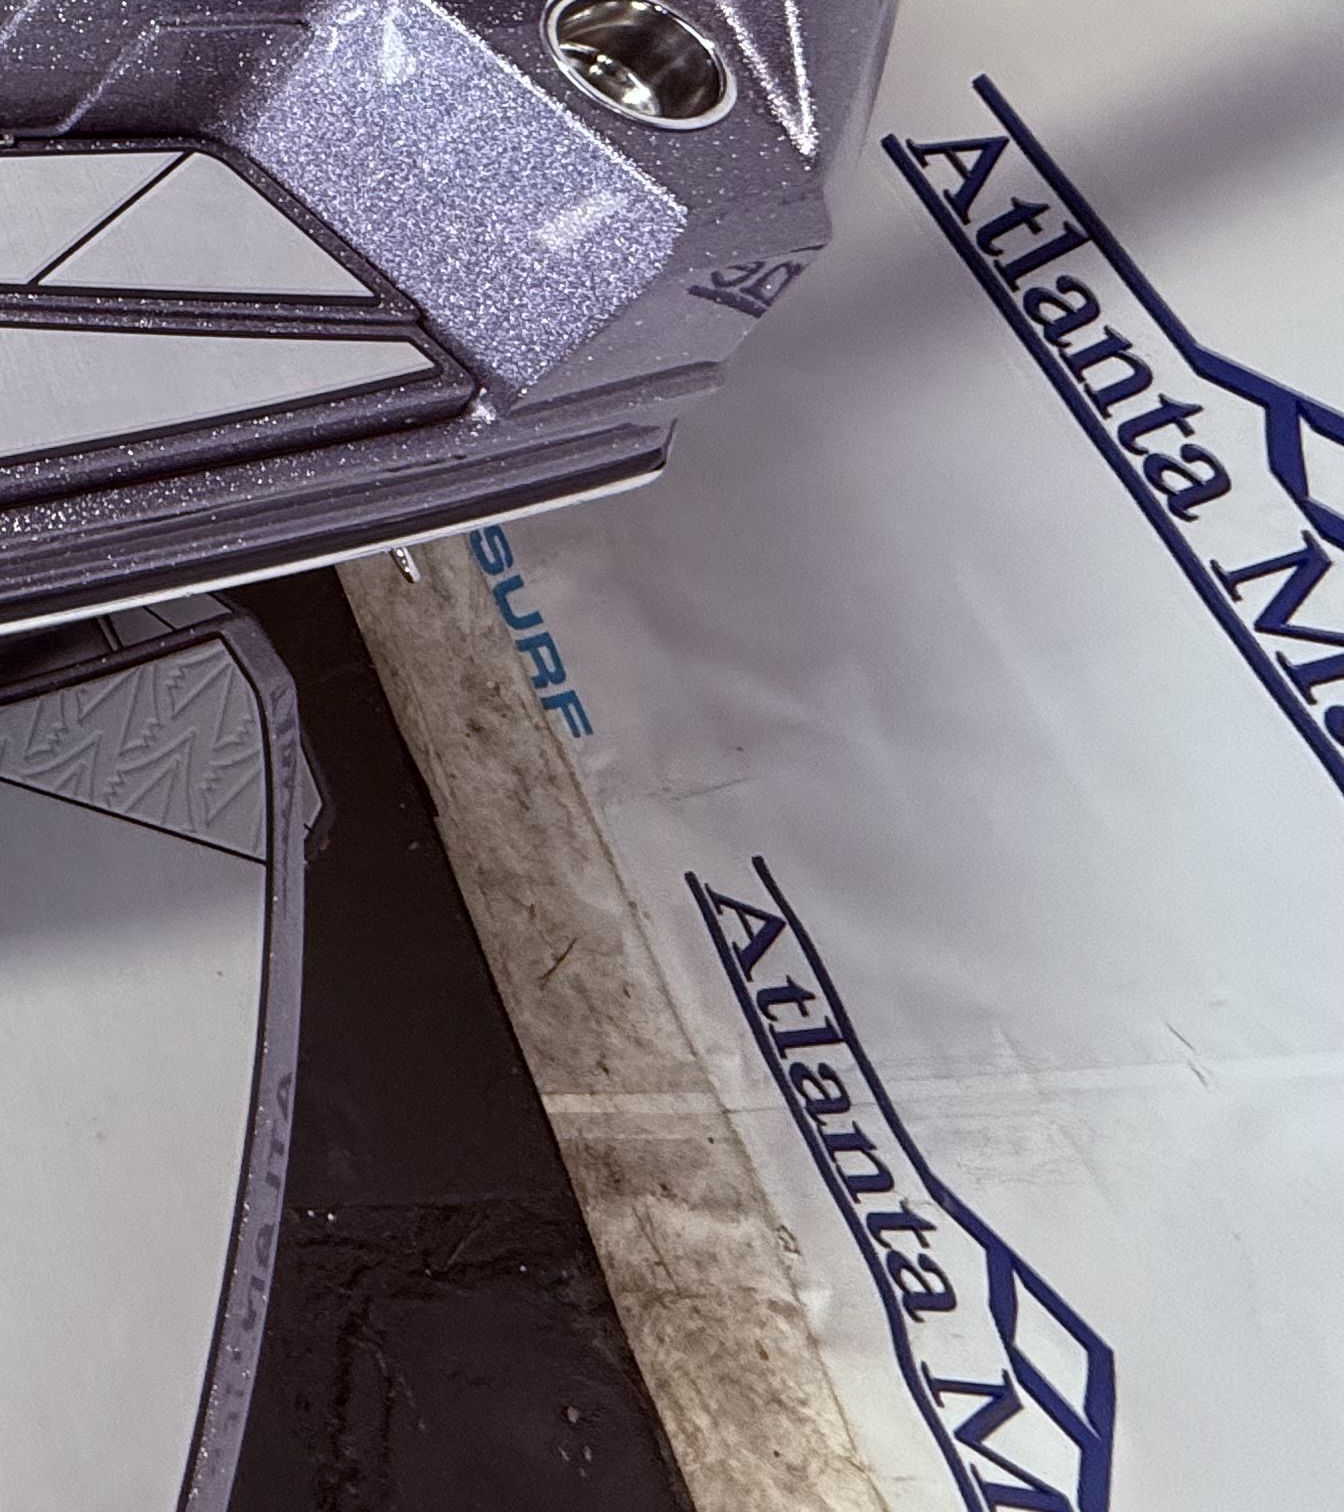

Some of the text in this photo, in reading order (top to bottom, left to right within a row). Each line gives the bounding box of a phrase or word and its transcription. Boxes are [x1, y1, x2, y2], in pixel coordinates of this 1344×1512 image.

[906, 136, 1232, 522] Atlanta
[469, 524, 594, 738] SURF
[705, 883, 957, 1323] Atlanta
